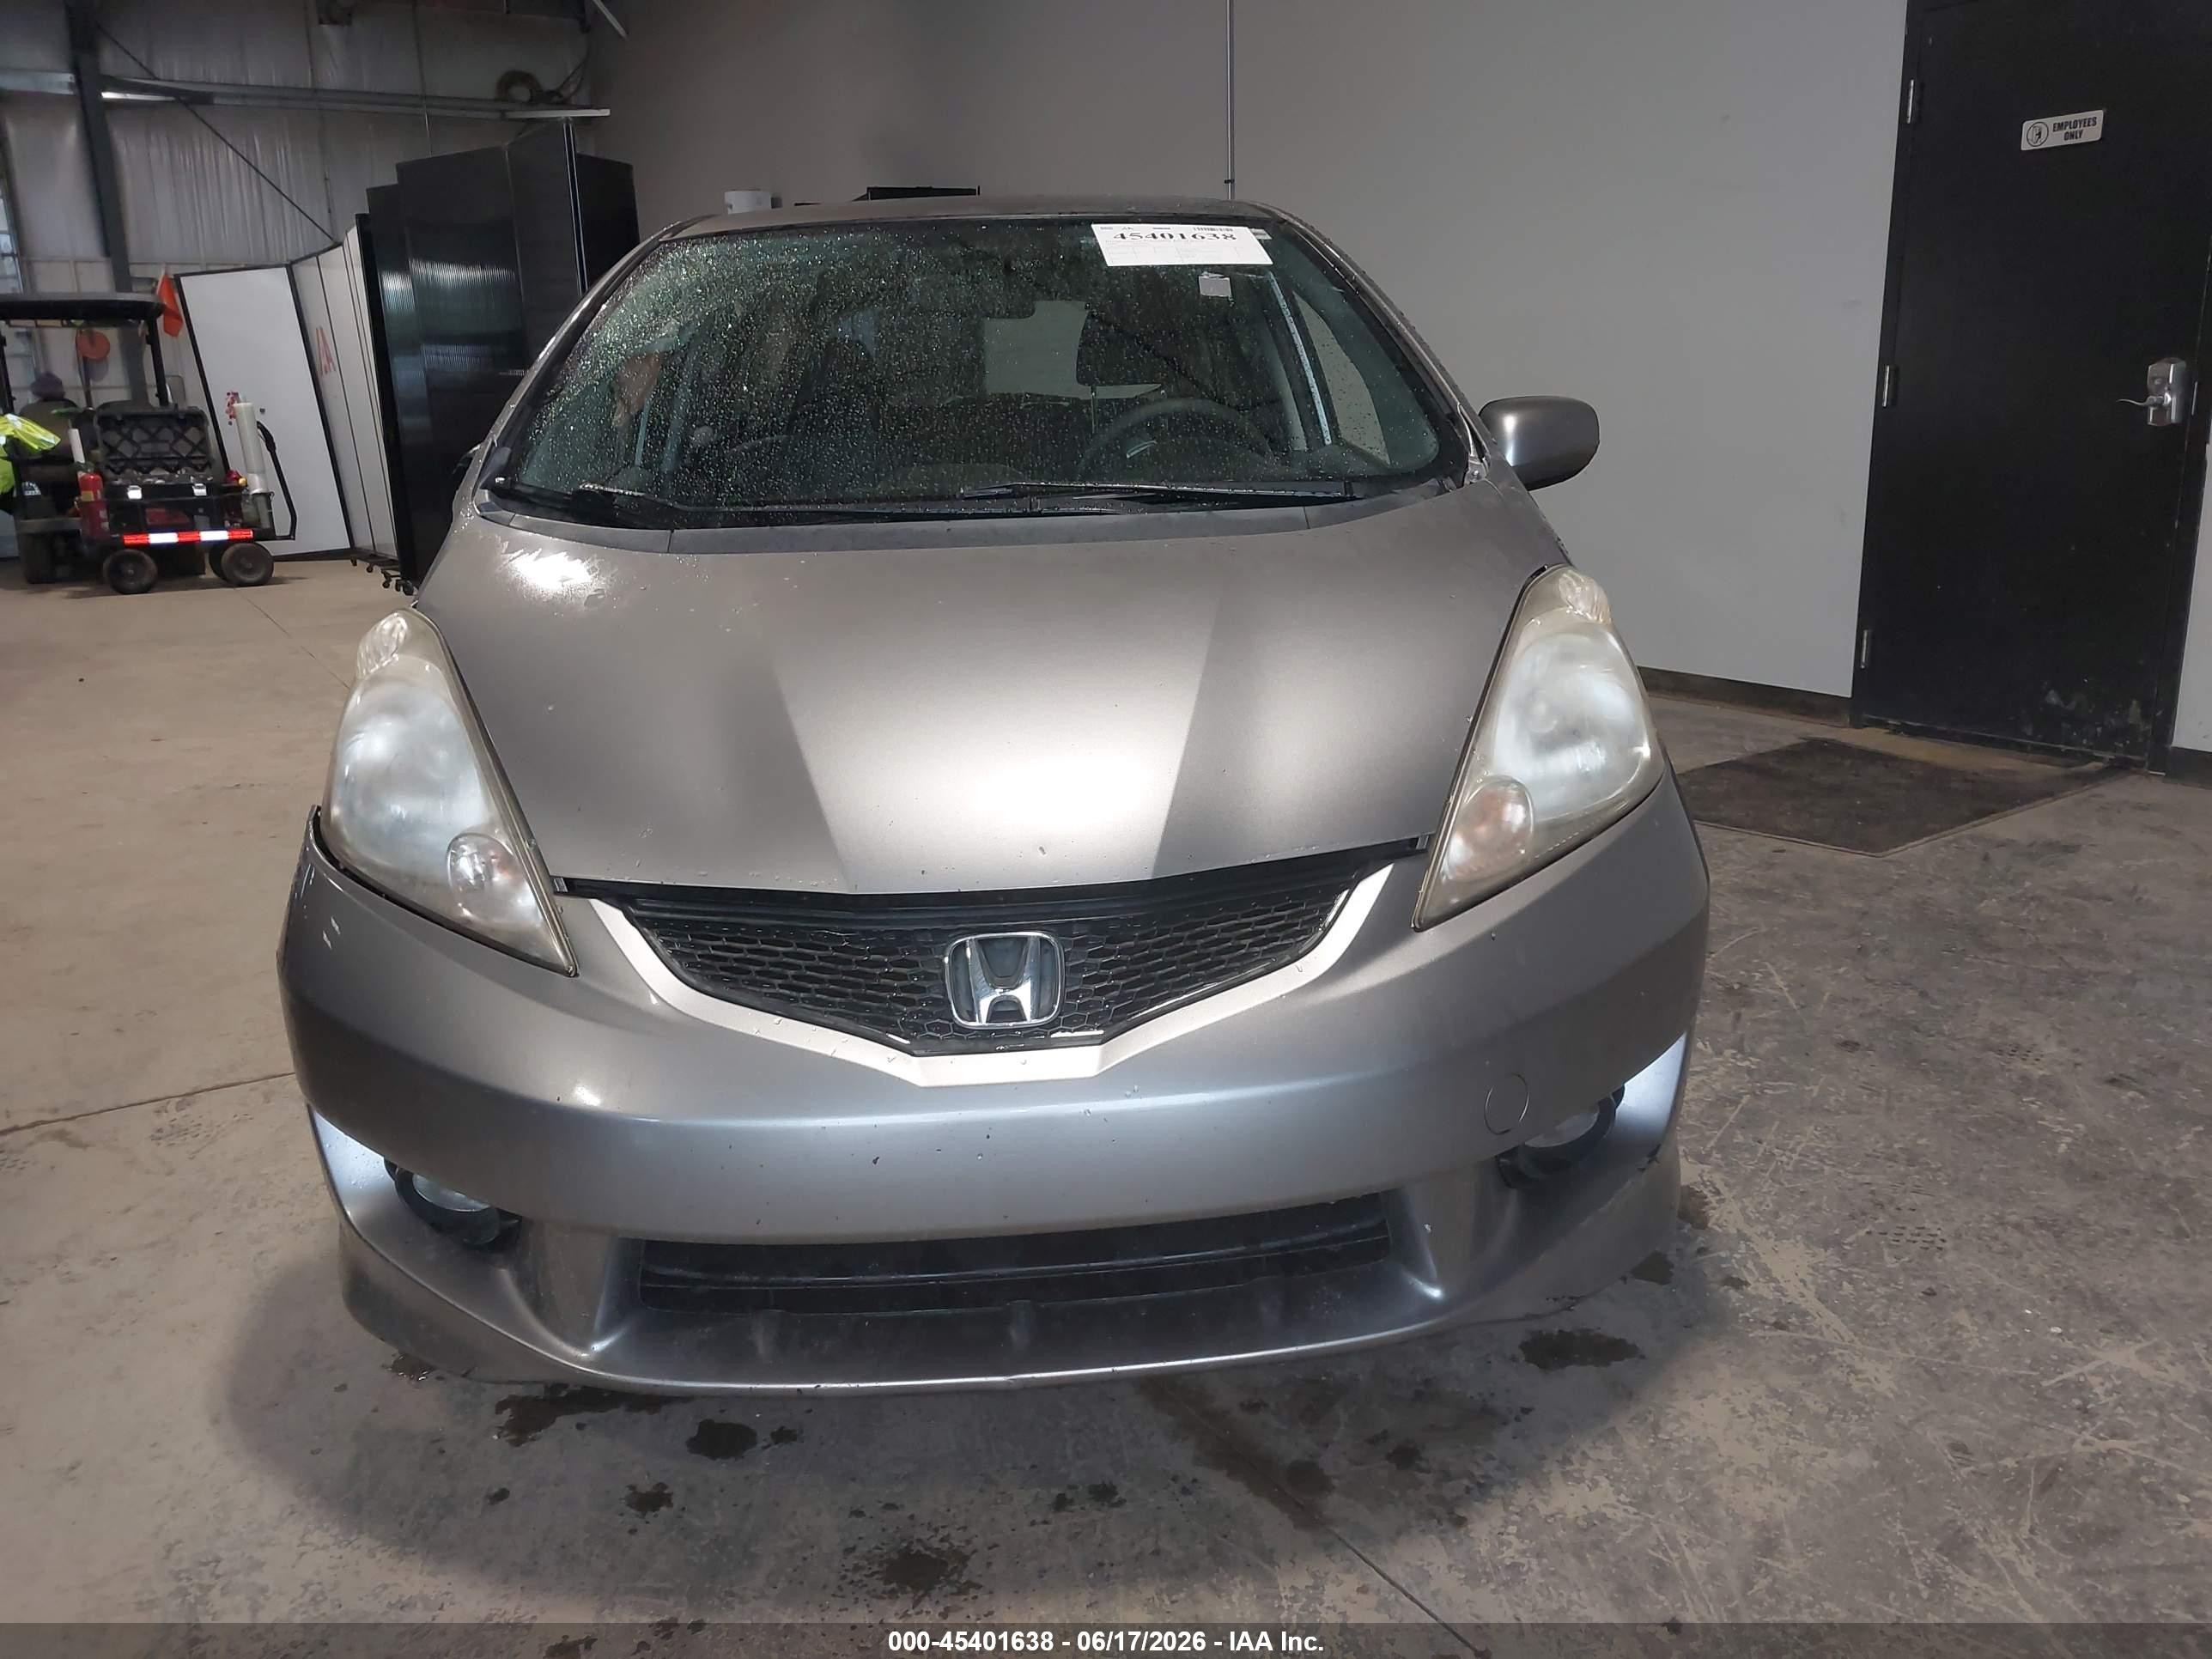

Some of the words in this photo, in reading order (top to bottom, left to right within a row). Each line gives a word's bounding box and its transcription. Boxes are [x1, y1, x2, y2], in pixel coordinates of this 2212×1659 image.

[2052, 117, 2097, 131] EMPLOYEES
[2063, 131, 2083, 141] ONLY
[1113, 232, 1237, 240] 45401638
